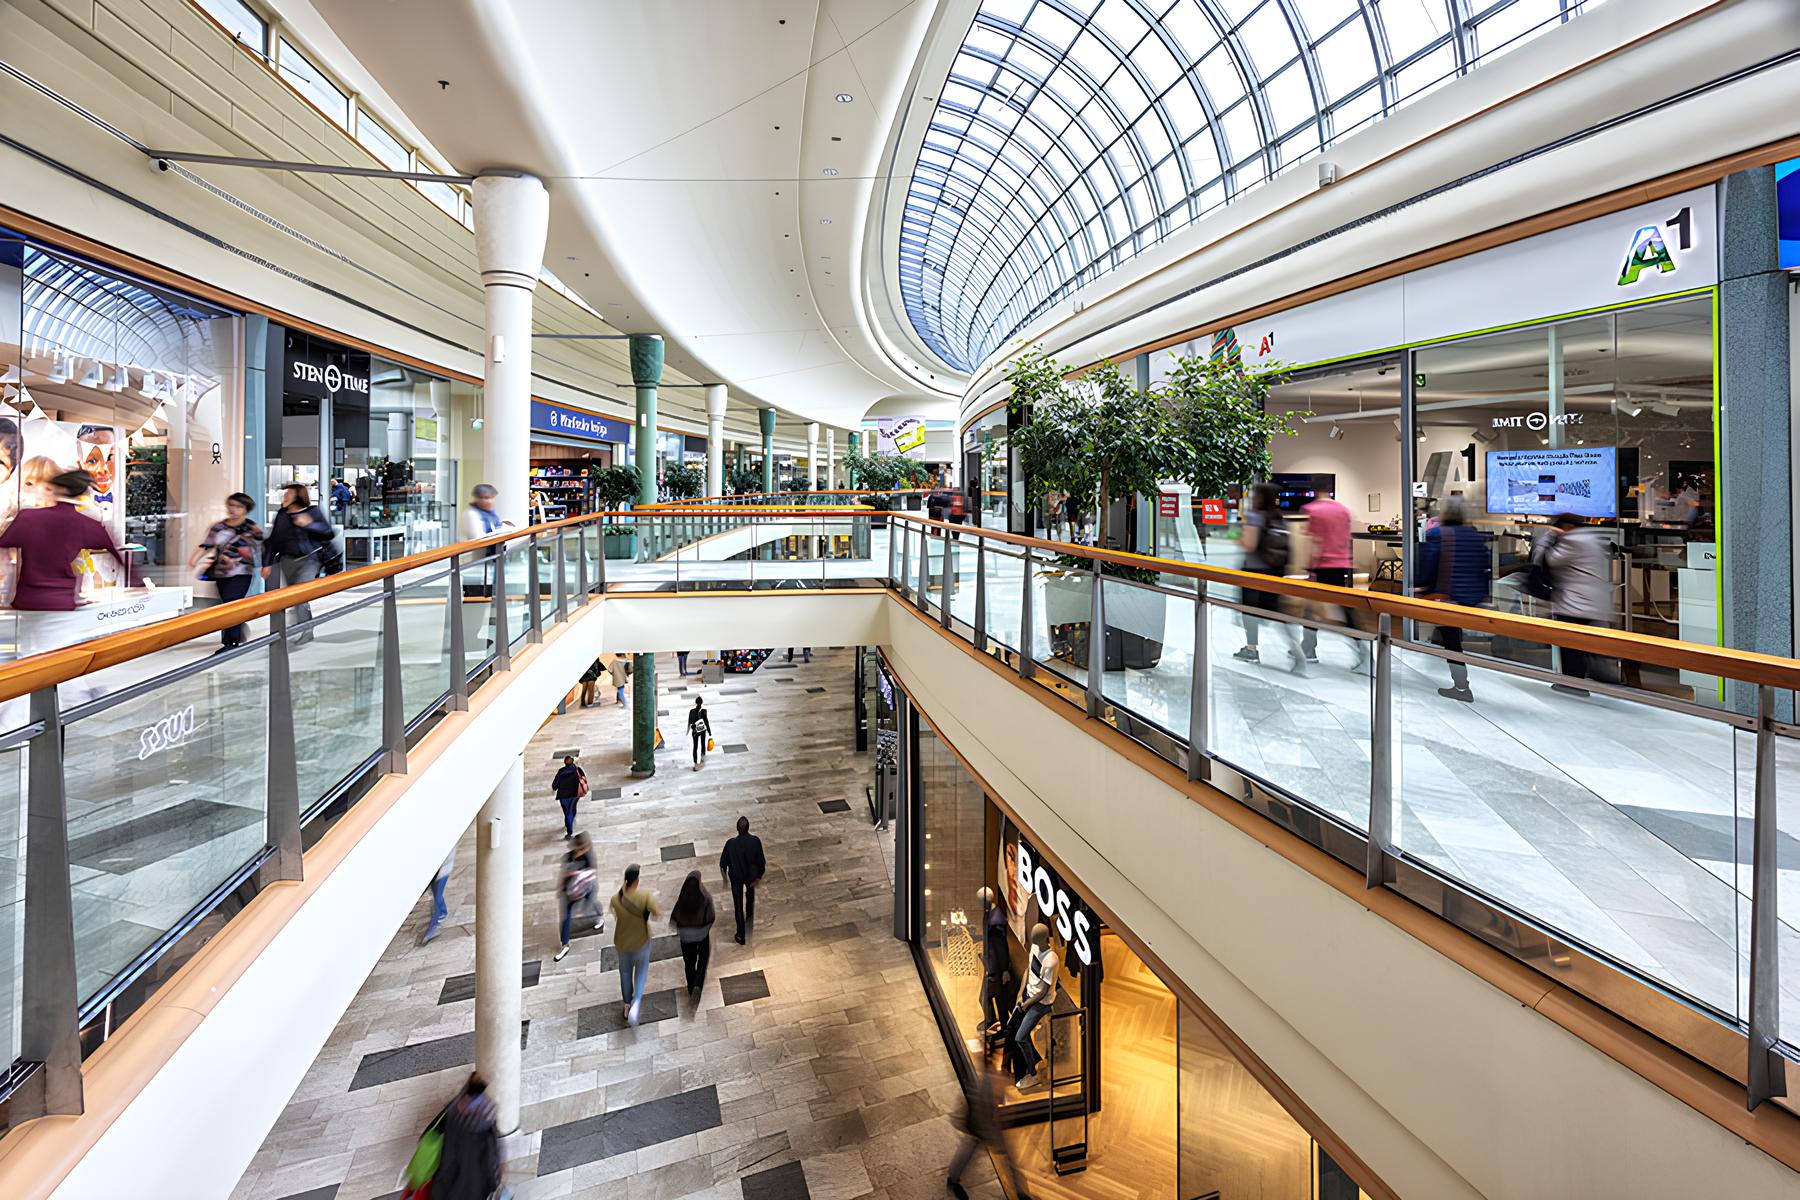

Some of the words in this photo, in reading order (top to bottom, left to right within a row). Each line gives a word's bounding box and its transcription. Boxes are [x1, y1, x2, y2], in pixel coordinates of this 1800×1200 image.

[1617, 206, 1691, 286] A1
[1258, 331, 1274, 357] A1
[1018, 843, 1092, 966] BOSS
